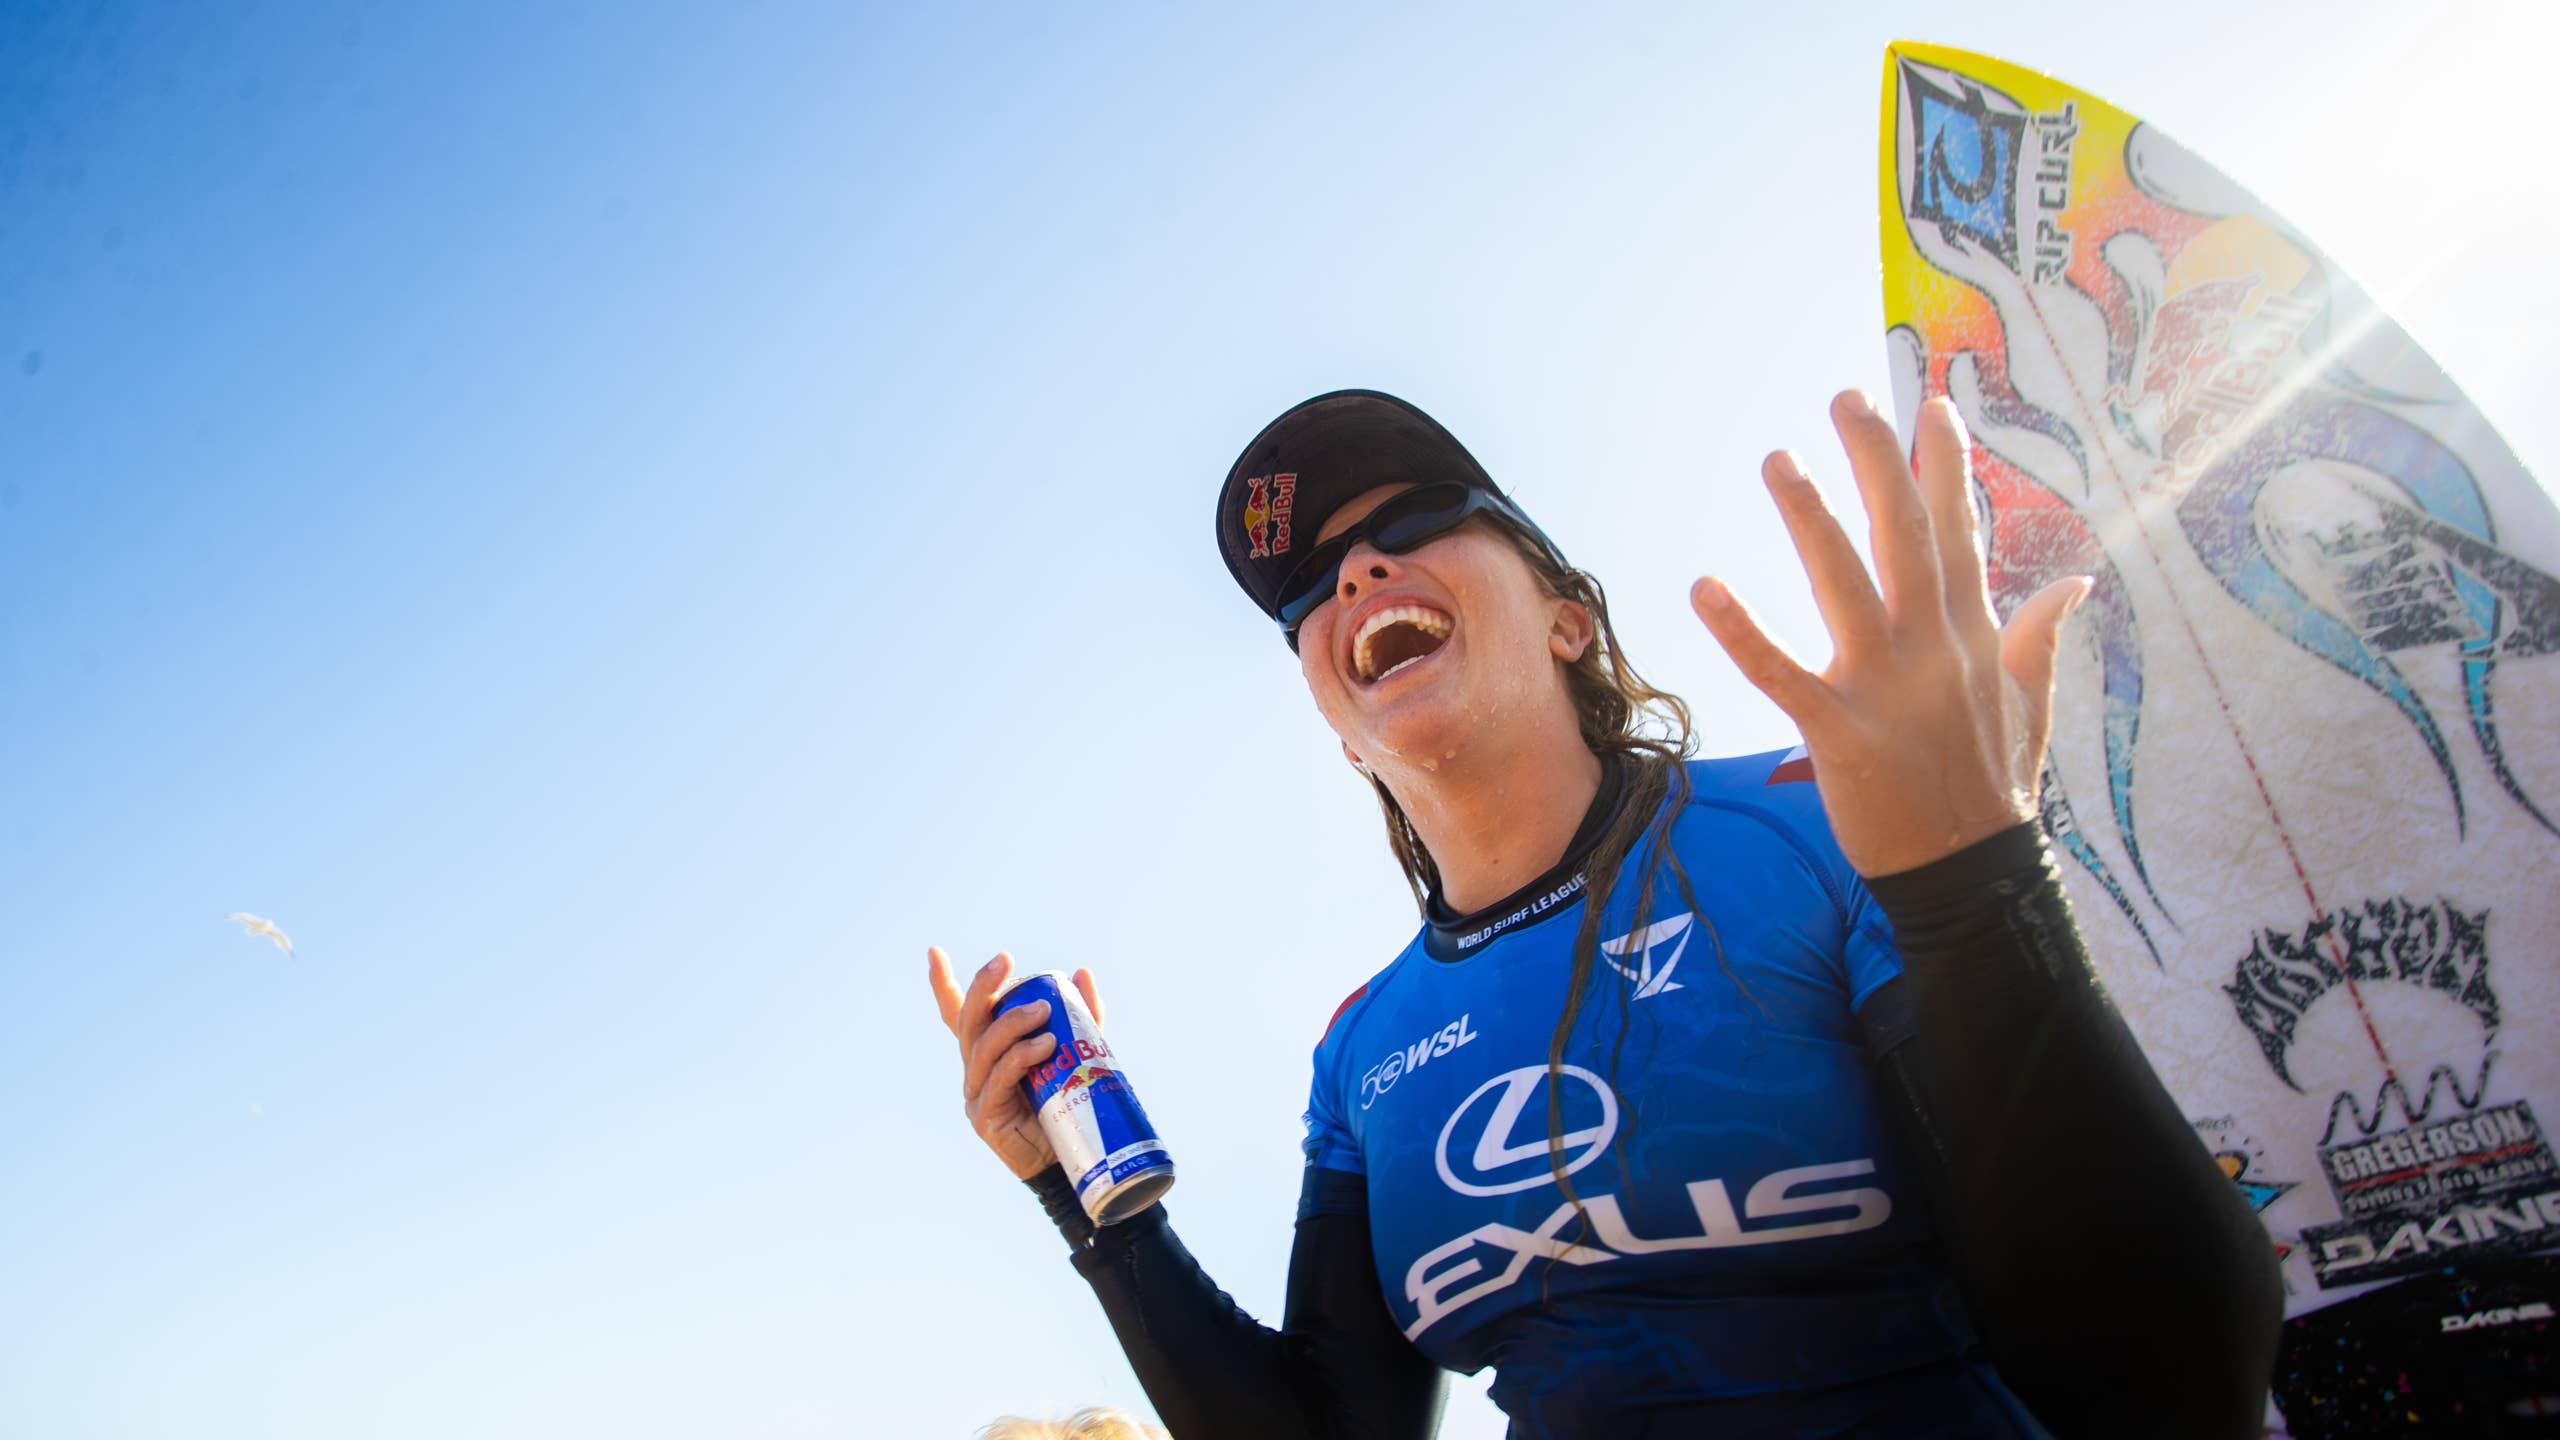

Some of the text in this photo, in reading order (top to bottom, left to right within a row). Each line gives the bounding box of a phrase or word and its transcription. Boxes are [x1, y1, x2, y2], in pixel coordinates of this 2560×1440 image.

[2033, 103, 2080, 285] RIP CURL
[1271, 473, 1297, 556] Red Bull
[1457, 871, 1588, 950] WORLD SURF LEAGUE
[1027, 1043, 1077, 1093] Red
[1405, 1013, 1478, 1074] WSL
[2331, 1106, 2530, 1183] GREGERSON
